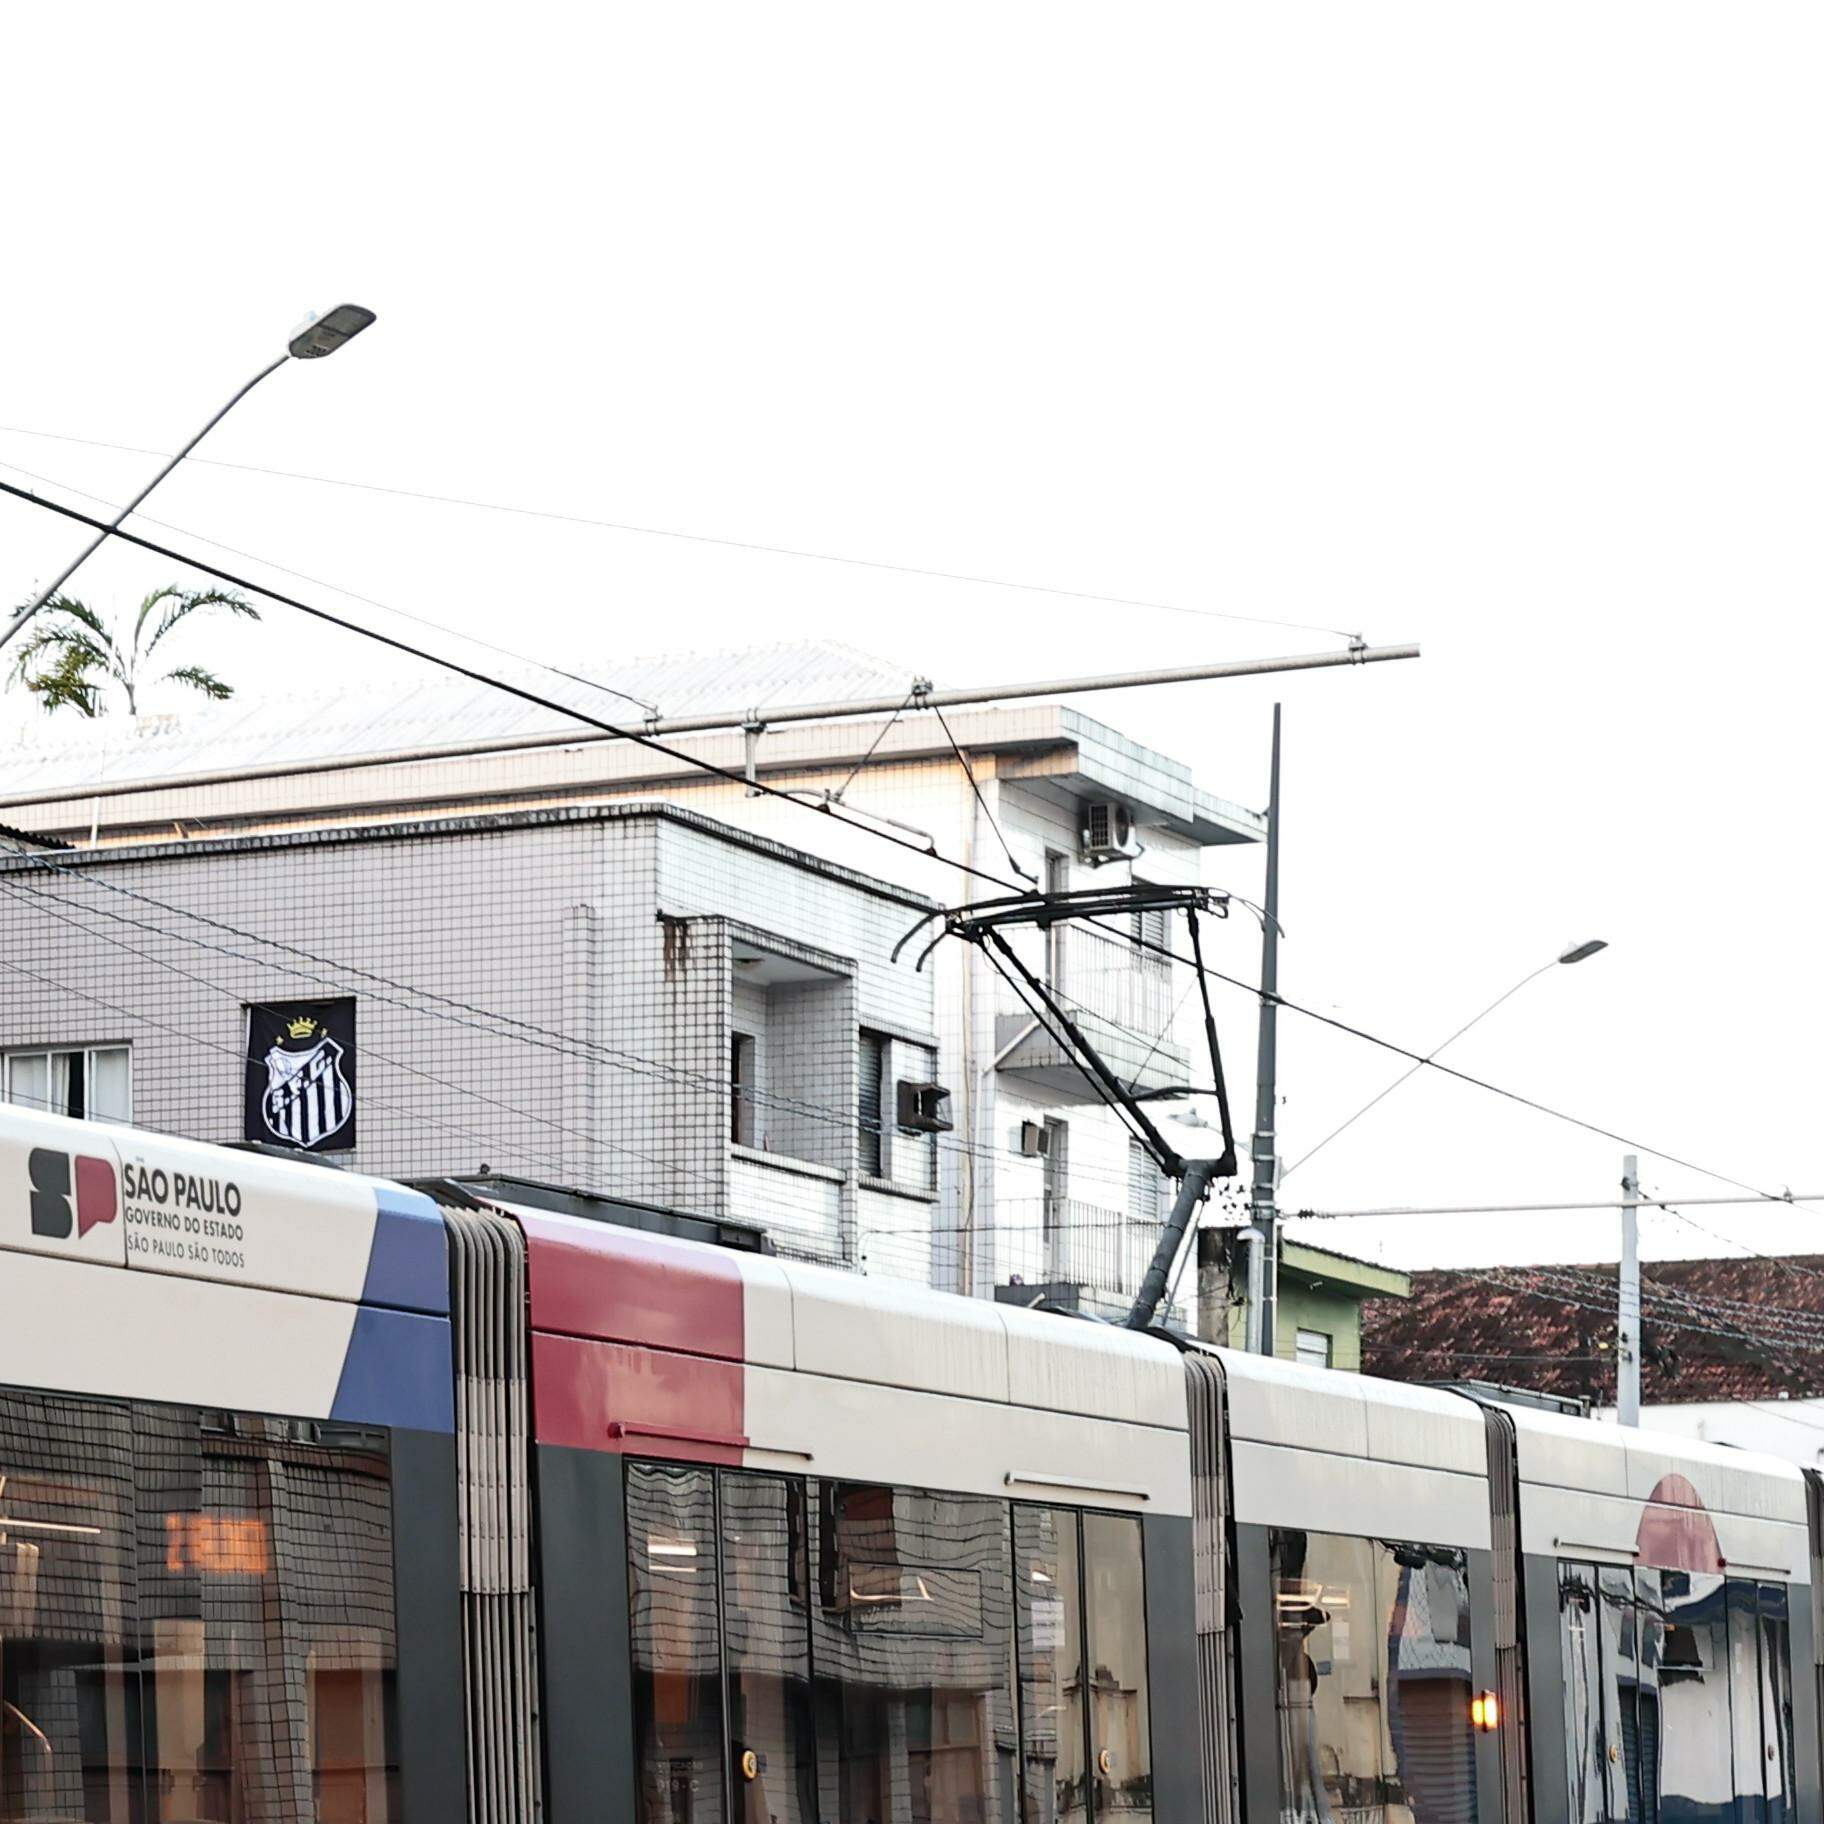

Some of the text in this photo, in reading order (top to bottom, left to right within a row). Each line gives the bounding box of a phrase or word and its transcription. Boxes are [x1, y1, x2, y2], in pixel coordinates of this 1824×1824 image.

[124, 1156, 242, 1217] SÃO PAULO
[125, 1206, 244, 1241] GOVERNO DO ESTADO
[127, 1232, 245, 1268] SÃO PAULO SÃO TODOS
